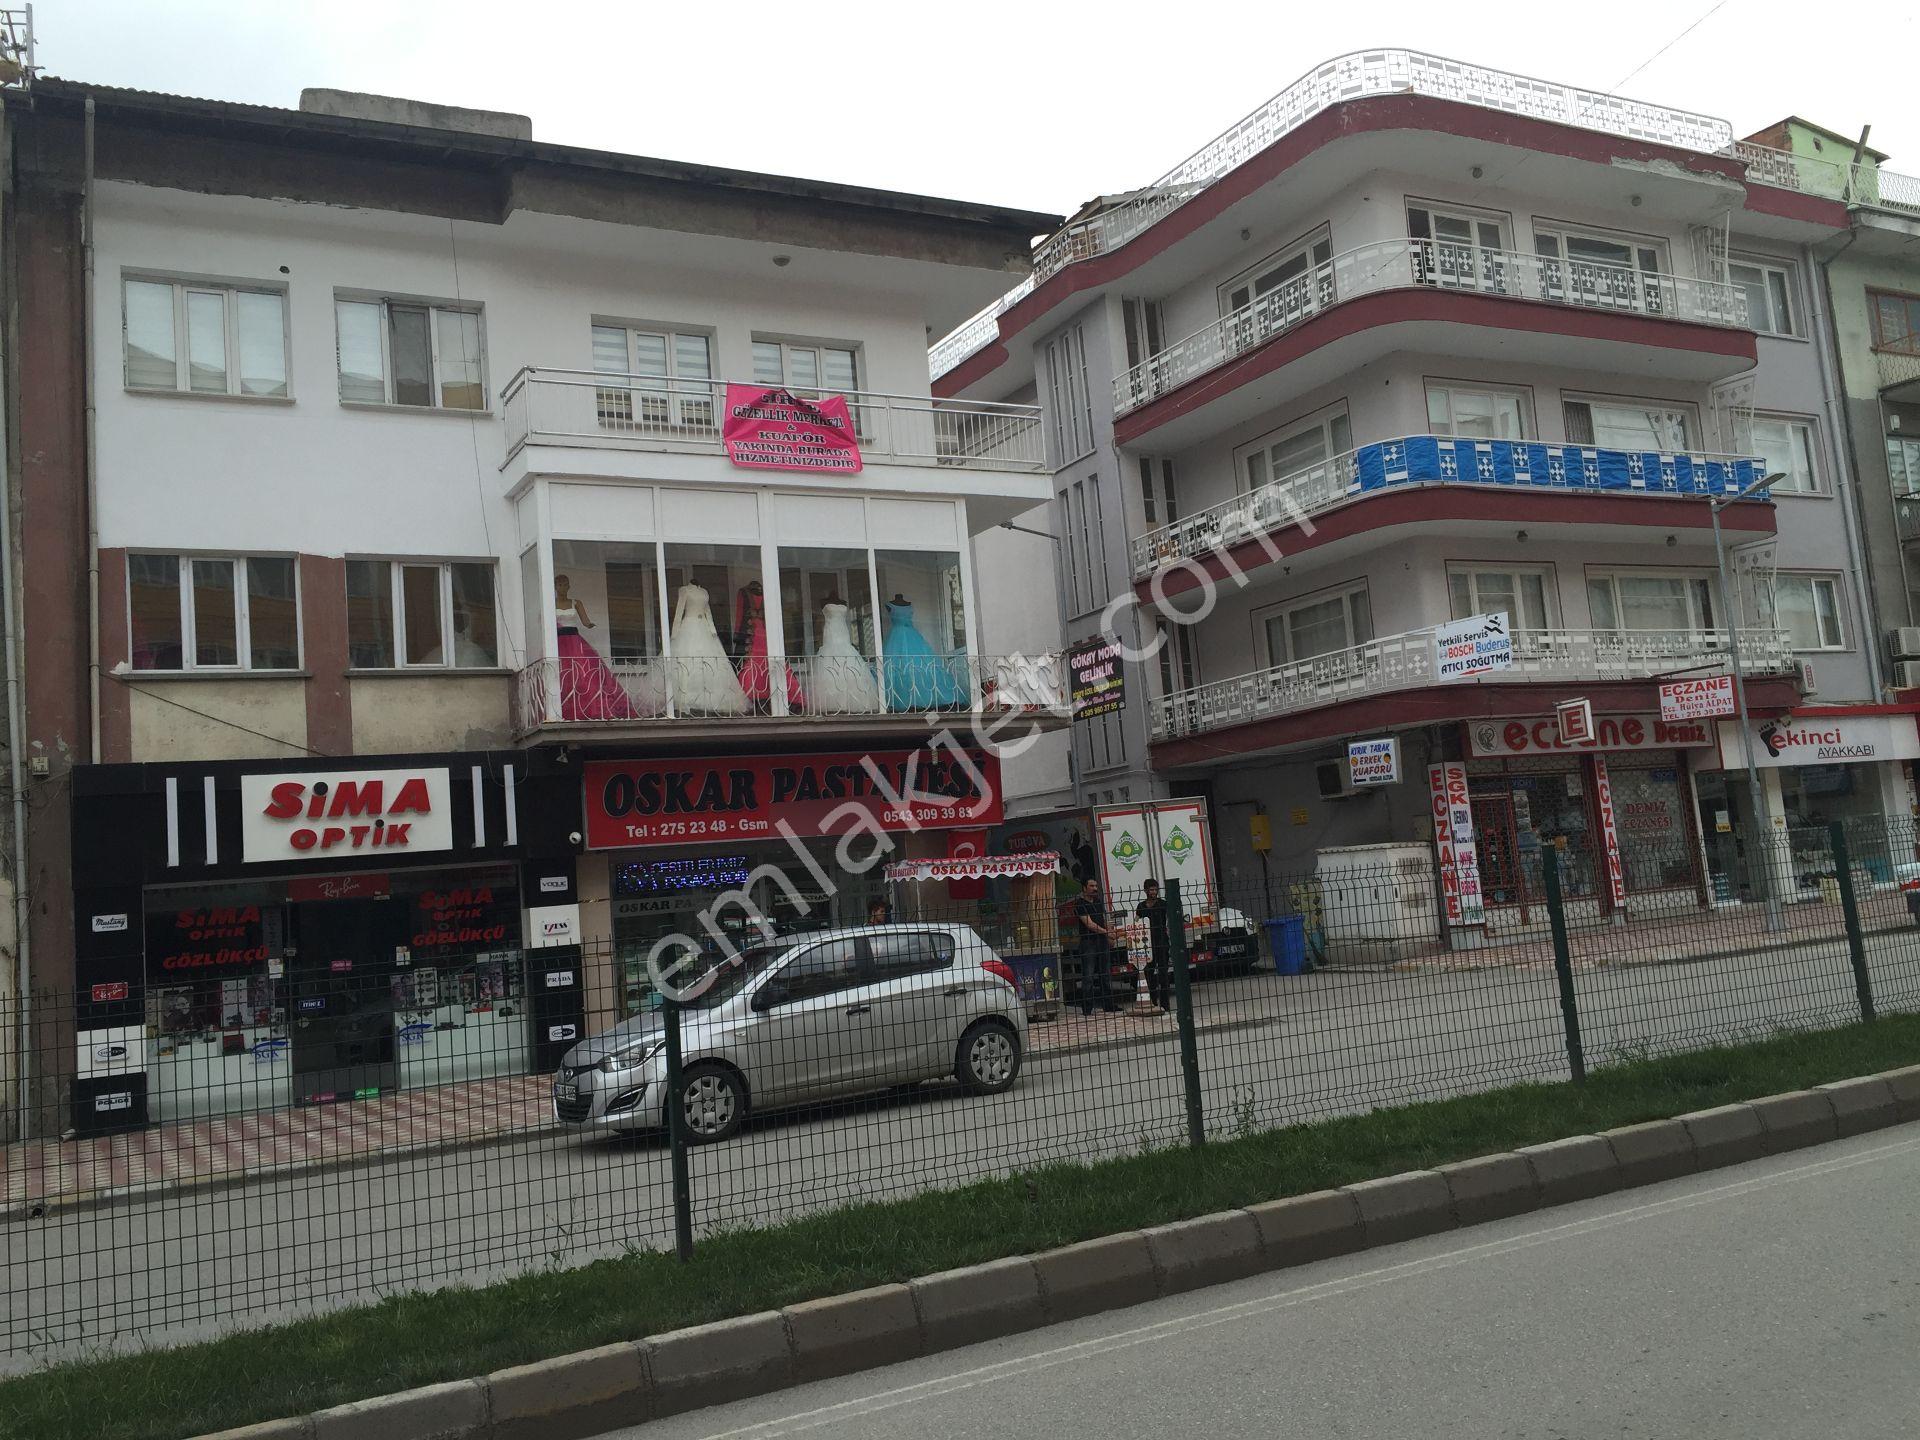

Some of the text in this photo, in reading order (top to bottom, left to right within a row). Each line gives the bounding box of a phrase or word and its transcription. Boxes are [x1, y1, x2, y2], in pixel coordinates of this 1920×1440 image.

[759, 432, 826, 443] KUAFÖR
[734, 441, 852, 457] YAKINDA BURADA
[1438, 629, 1488, 647] Yetkili Servis
[1448, 639, 1509, 658] BOSCH Buderus
[1071, 650, 1096, 669] GÖKAY
[1441, 652, 1510, 674] ATICI SOĞUTMA
[1662, 678, 1729, 697] ECZANE
[1675, 693, 1717, 703] Deniz
[1565, 710, 1583, 735] E
[1770, 728, 1841, 749] ekinci
[1360, 755, 1382, 765] ERKEK
[1818, 745, 1875, 759] AYAKKABI
[603, 769, 759, 818] OSKAR
[1447, 768, 1468, 805] SGK
[884, 806, 973, 823] 0543 309 39 83
[626, 825, 647, 838] Tel
[661, 822, 685, 835] 275
[689, 821, 706, 833] 23
[710, 820, 726, 832] 48
[739, 819, 768, 831] Gsm
[1595, 759, 1625, 900] ECZANE
[1430, 769, 1461, 919] ECZANE
[931, 864, 978, 876] OSKAR
[319, 878, 361, 898] Ray-Ban
[619, 900, 671, 914] OSKAR
[95, 917, 125, 928] Mustang
[412, 924, 505, 947] GÖZLÜKÇÜ
[162, 944, 270, 970] GÖZLÜKÇÜ
